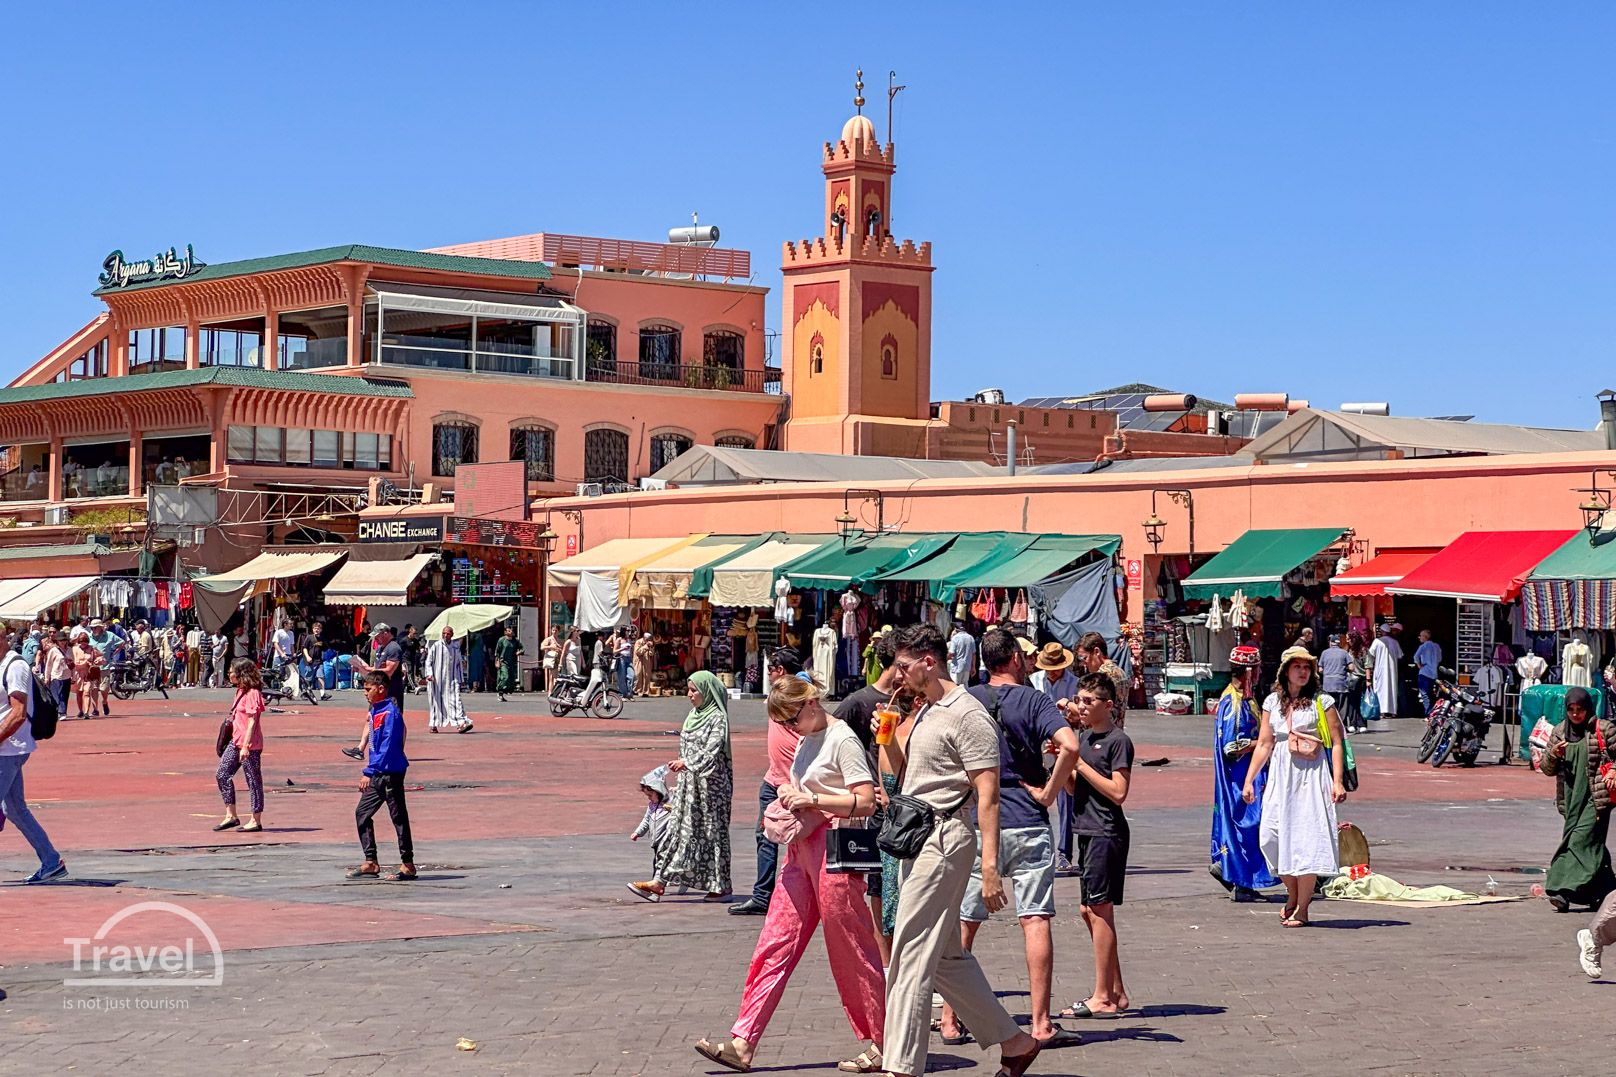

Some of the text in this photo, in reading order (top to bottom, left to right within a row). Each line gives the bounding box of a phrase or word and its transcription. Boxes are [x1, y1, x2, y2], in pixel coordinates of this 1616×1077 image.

[98, 249, 154, 288] Argana
[359, 521, 407, 539] CHANGE
[407, 527, 438, 537] EXCHANGE
